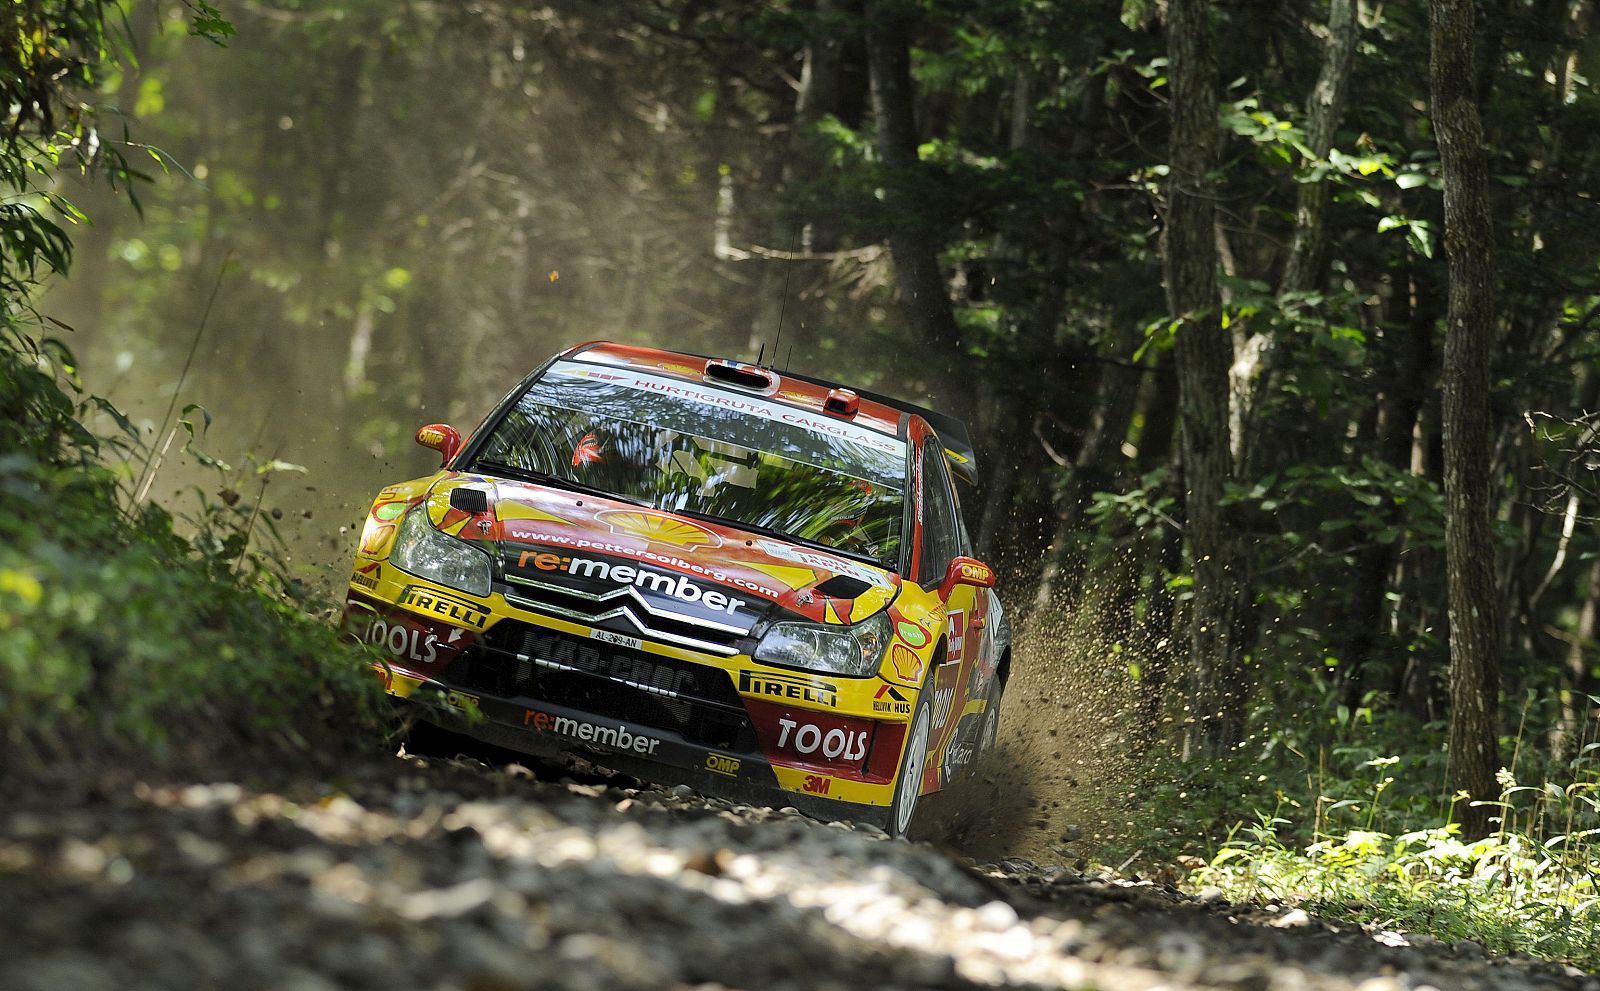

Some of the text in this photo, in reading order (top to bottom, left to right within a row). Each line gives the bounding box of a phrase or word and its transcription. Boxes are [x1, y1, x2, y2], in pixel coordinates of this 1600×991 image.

[634, 379, 897, 452] HURTIGRUTA CARGLASS
[418, 431, 444, 446] OMP
[511, 530, 779, 599] www.pettersolberg.com
[517, 549, 746, 616] re:member
[961, 564, 990, 581] OMP
[739, 669, 838, 708] PIRELLI
[894, 703, 911, 714] HUS
[523, 708, 661, 755] re:member
[777, 718, 867, 761] TOOLS
[705, 755, 740, 774] OMP
[802, 774, 831, 795] 3M
